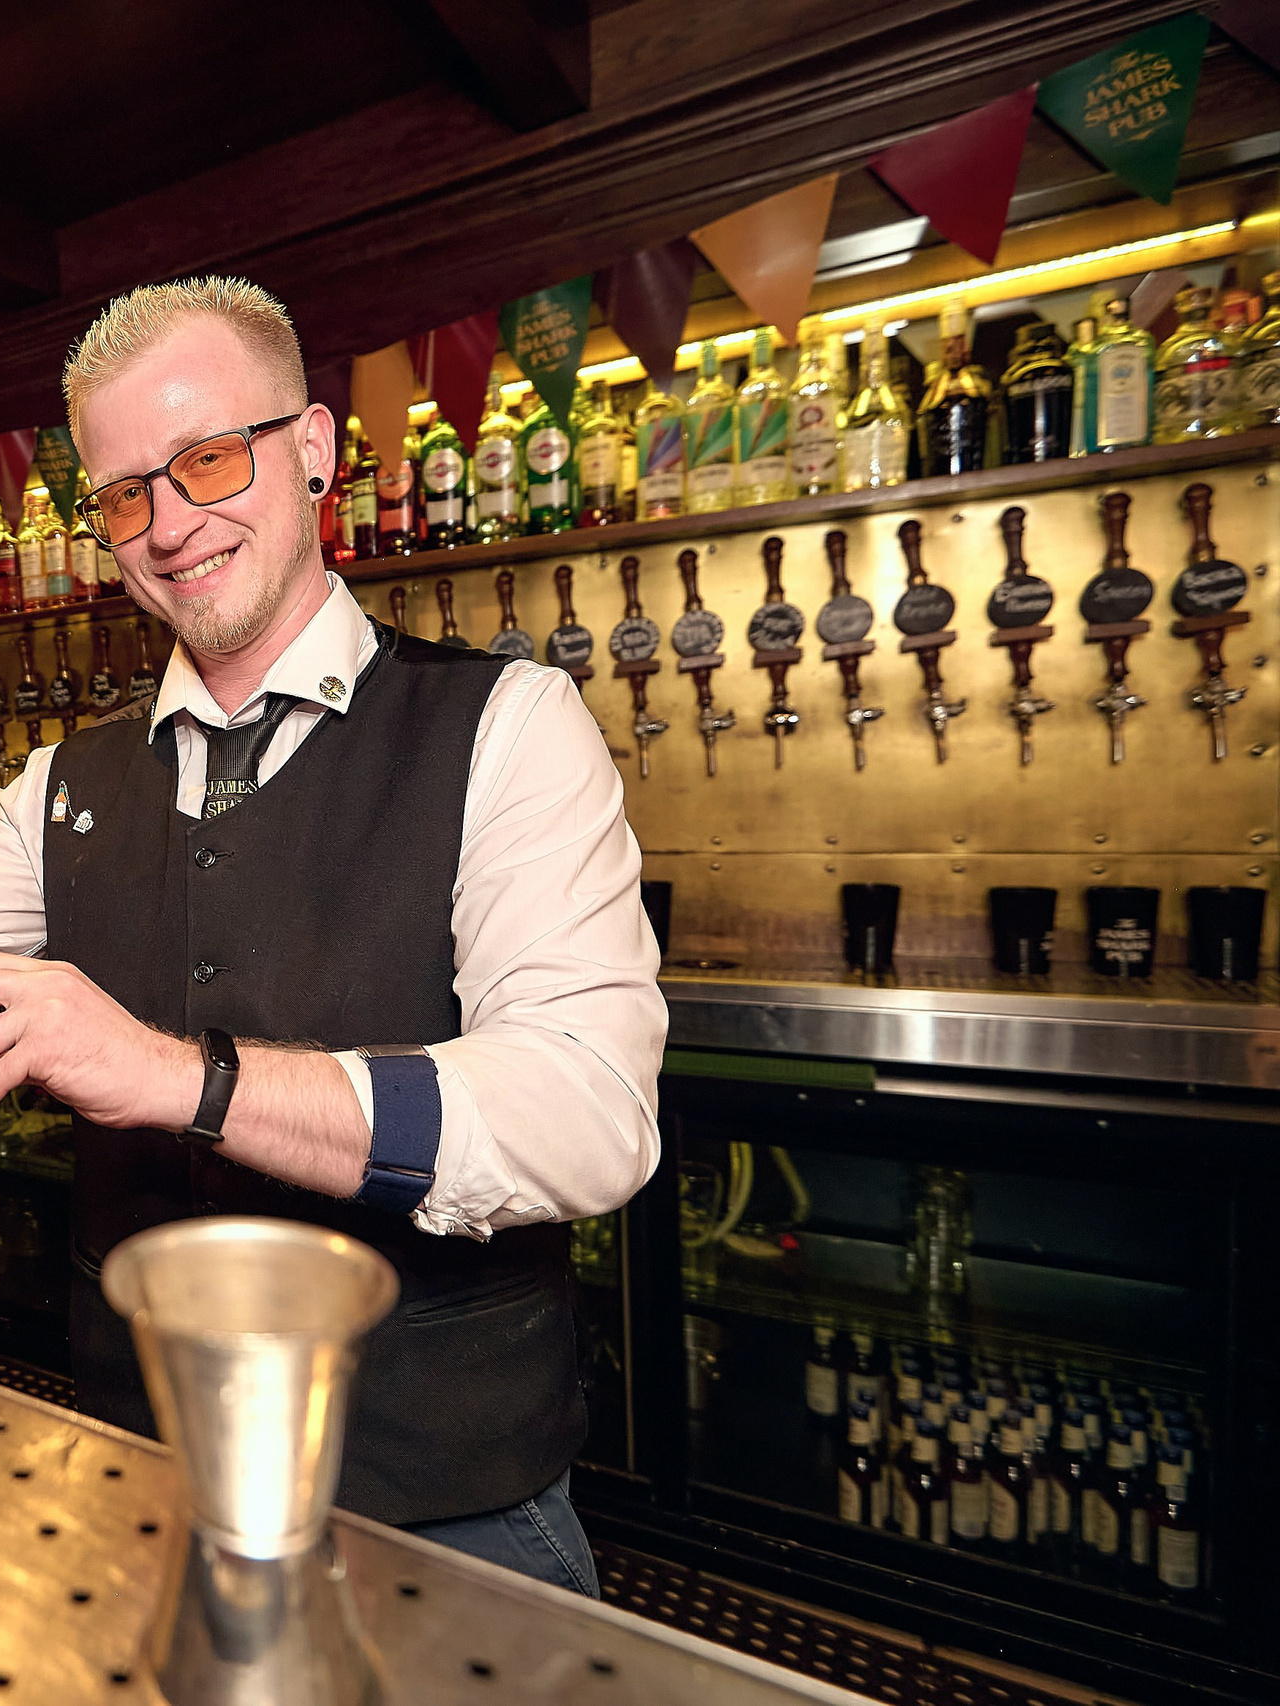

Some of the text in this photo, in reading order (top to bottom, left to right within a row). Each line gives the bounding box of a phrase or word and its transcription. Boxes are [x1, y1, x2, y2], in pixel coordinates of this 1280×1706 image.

[1084, 57, 1172, 110] JAMES
[1084, 74, 1182, 128] SHARK
[1108, 101, 1167, 138] PUB
[207, 780, 258, 795] JAMES
